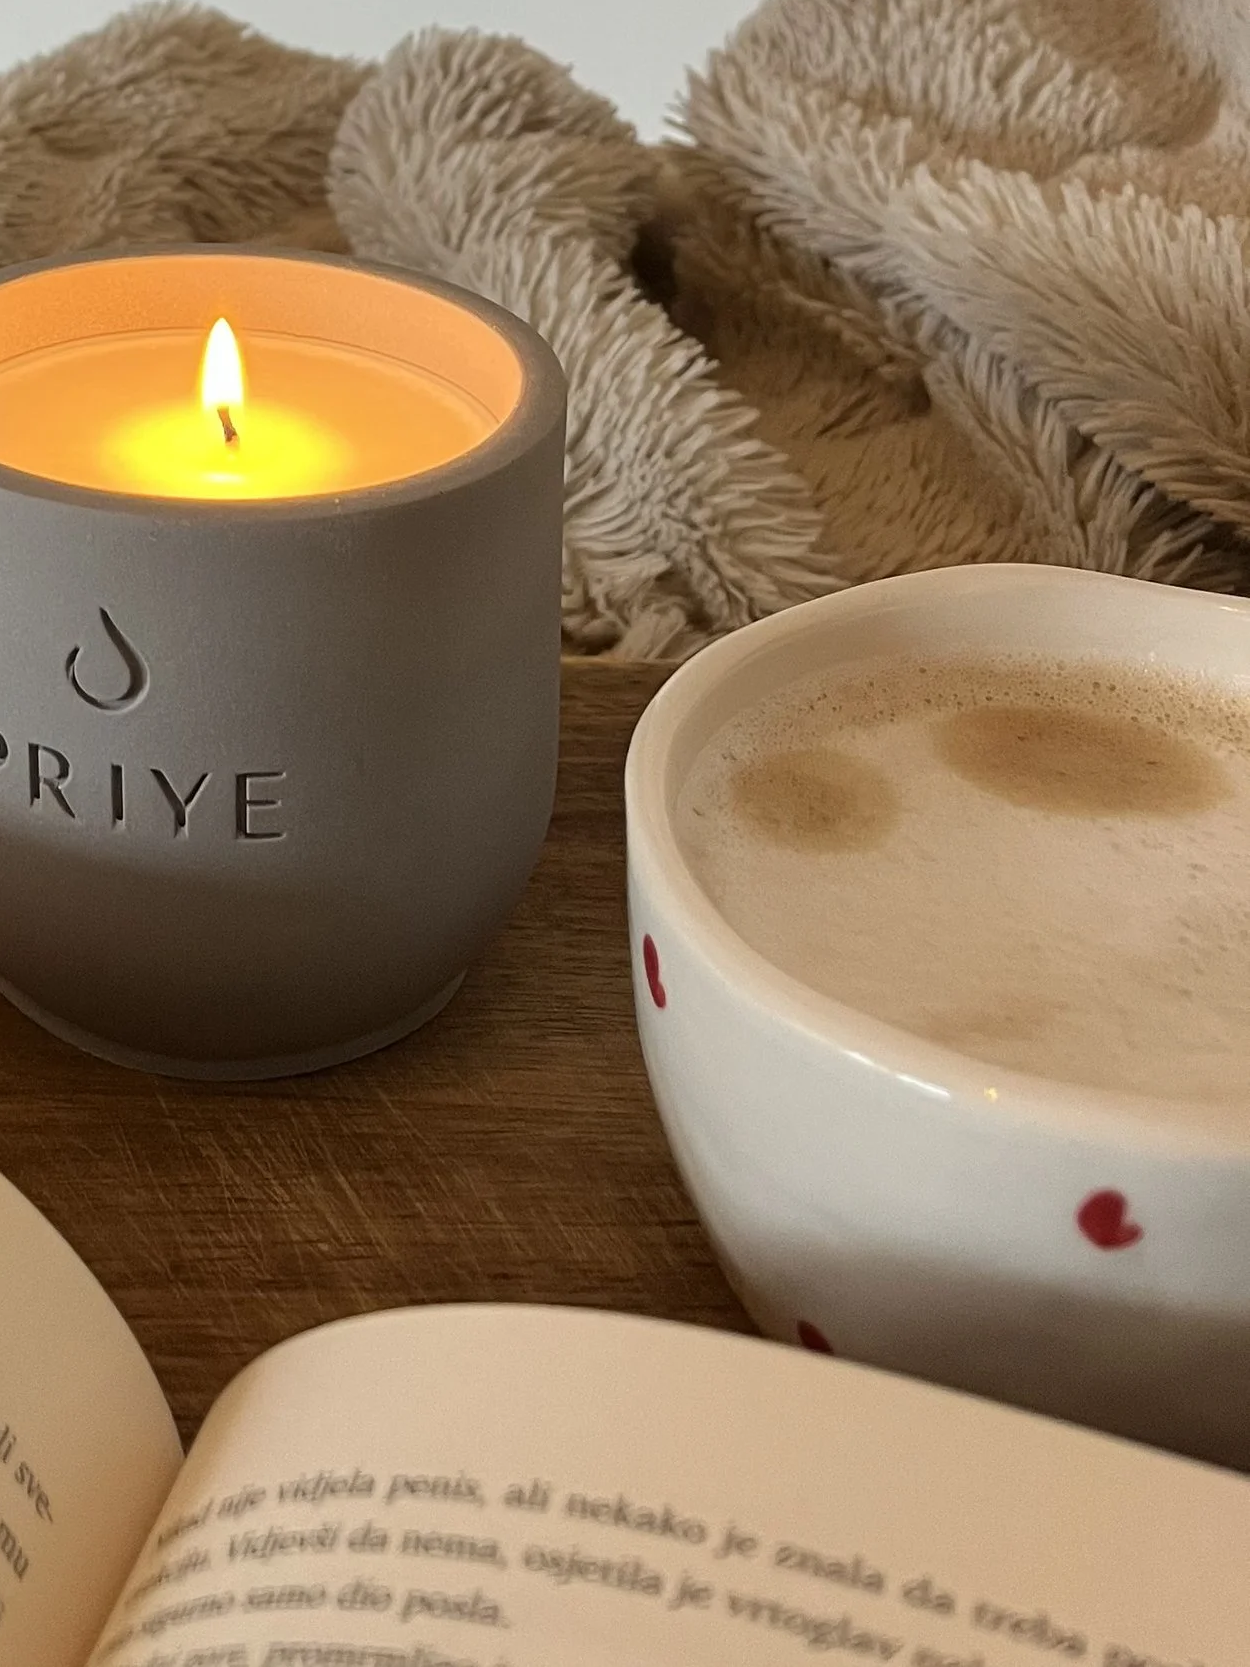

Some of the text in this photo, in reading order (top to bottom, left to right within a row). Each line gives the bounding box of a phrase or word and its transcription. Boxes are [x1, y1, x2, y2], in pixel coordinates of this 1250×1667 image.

[14, 1462, 53, 1522] sve-
[347, 1523, 389, 1552] da
[671, 1577, 712, 1609] je
[504, 1481, 549, 1512] ali
[565, 1495, 707, 1544] nekako
[717, 1527, 757, 1558] je
[775, 1546, 885, 1594] znala
[902, 1579, 955, 1615] da
